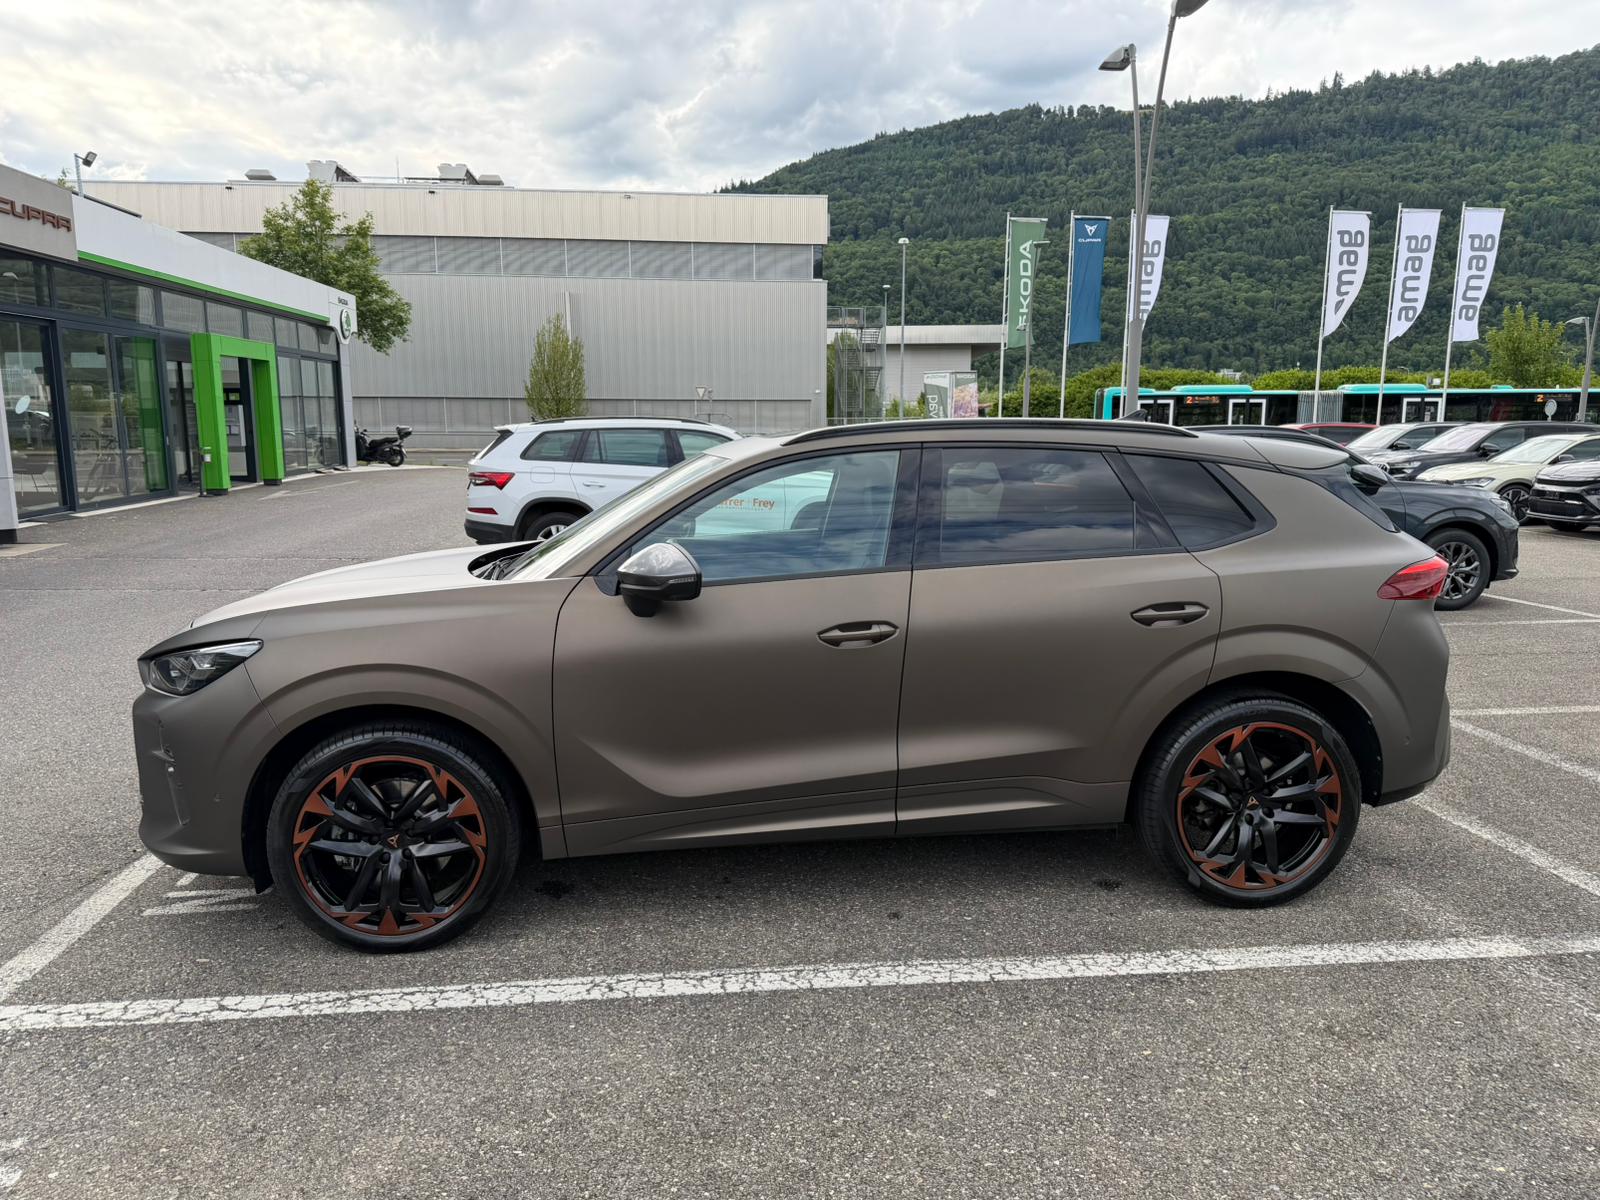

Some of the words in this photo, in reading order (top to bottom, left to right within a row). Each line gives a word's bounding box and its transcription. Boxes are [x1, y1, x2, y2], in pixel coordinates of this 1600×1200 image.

[1397, 235, 1431, 322] amag
[1459, 234, 1496, 321] amag
[753, 498, 775, 510] Frey
